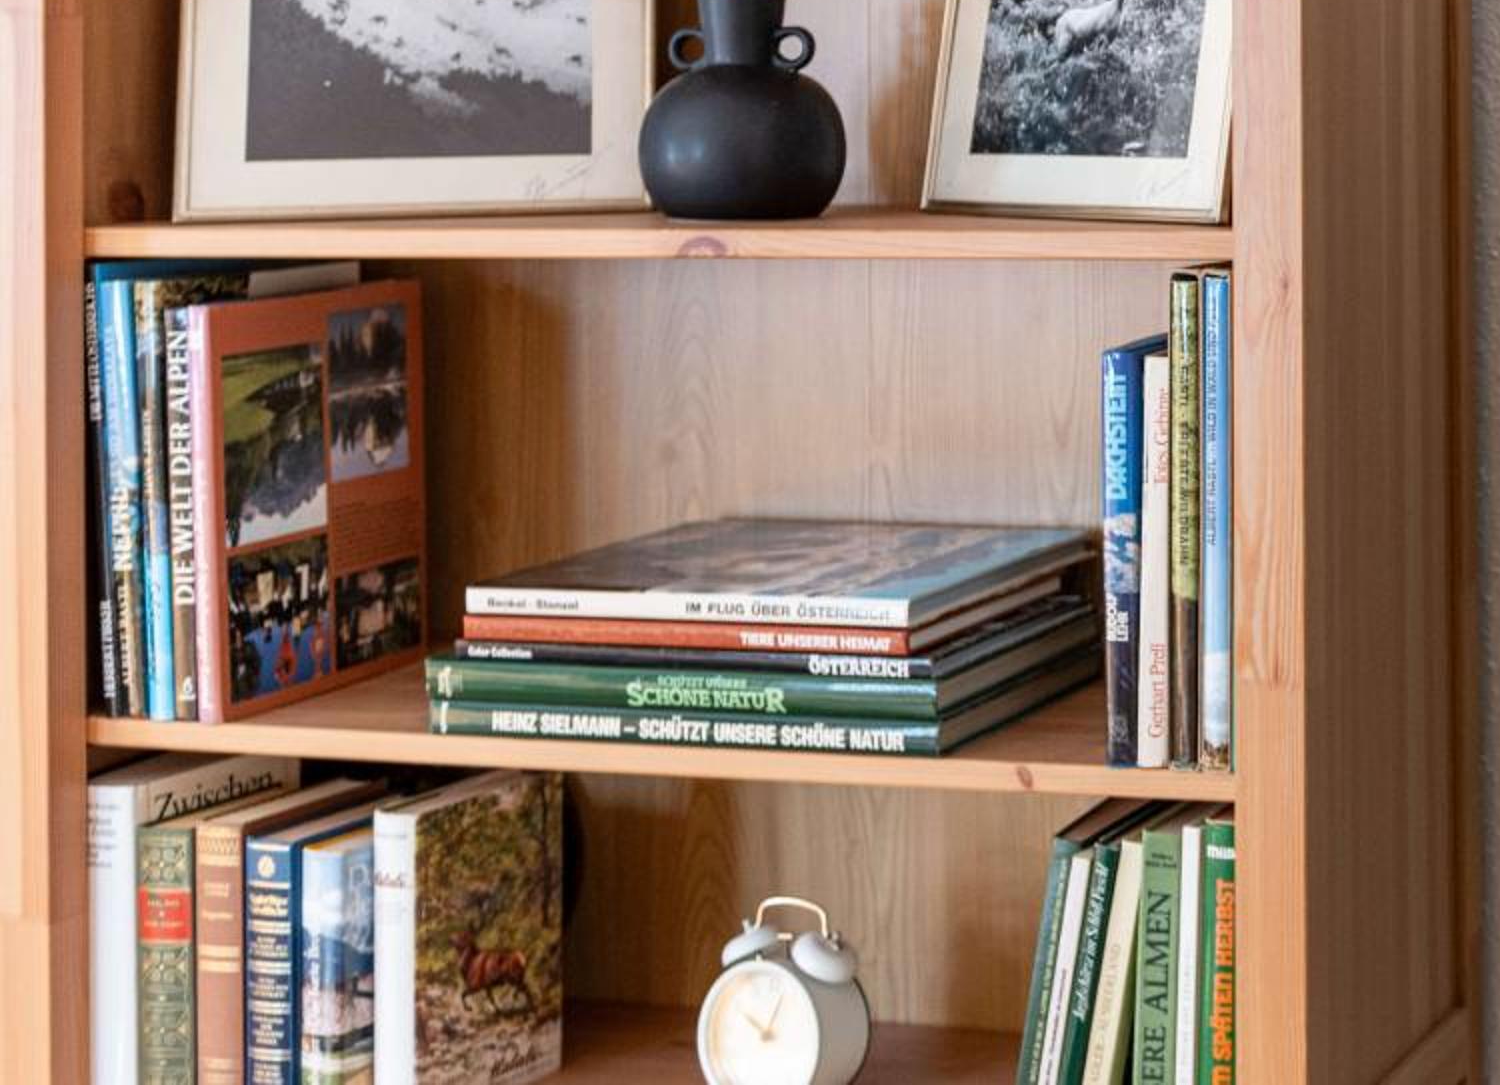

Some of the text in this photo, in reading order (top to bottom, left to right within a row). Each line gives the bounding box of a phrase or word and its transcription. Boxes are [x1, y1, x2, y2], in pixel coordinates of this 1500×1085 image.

[166, 330, 195, 606] DIE WELT DER ALPEN
[685, 601, 702, 613] IM
[707, 603, 745, 616] FLUG
[750, 601, 790, 617] ÜBER
[807, 654, 910, 678] ÖSTERREICH
[840, 635, 892, 652] HEIMAT
[625, 677, 787, 714] SCHÖNE NATUR
[1146, 680, 1168, 739] Gerhart
[491, 710, 537, 732] HEINZ
[540, 713, 621, 738] SIELMANN
[639, 715, 711, 743] SCHÜTZT
[713, 725, 777, 746] UNSERE
[780, 722, 847, 749] SCHÖNE
[849, 728, 905, 752] NATUR
[154, 770, 273, 822] Zwischen
[1214, 880, 1234, 966] HERBST
[1143, 889, 1172, 1015] ALMEN
[1142, 1026, 1165, 1085] ERE
